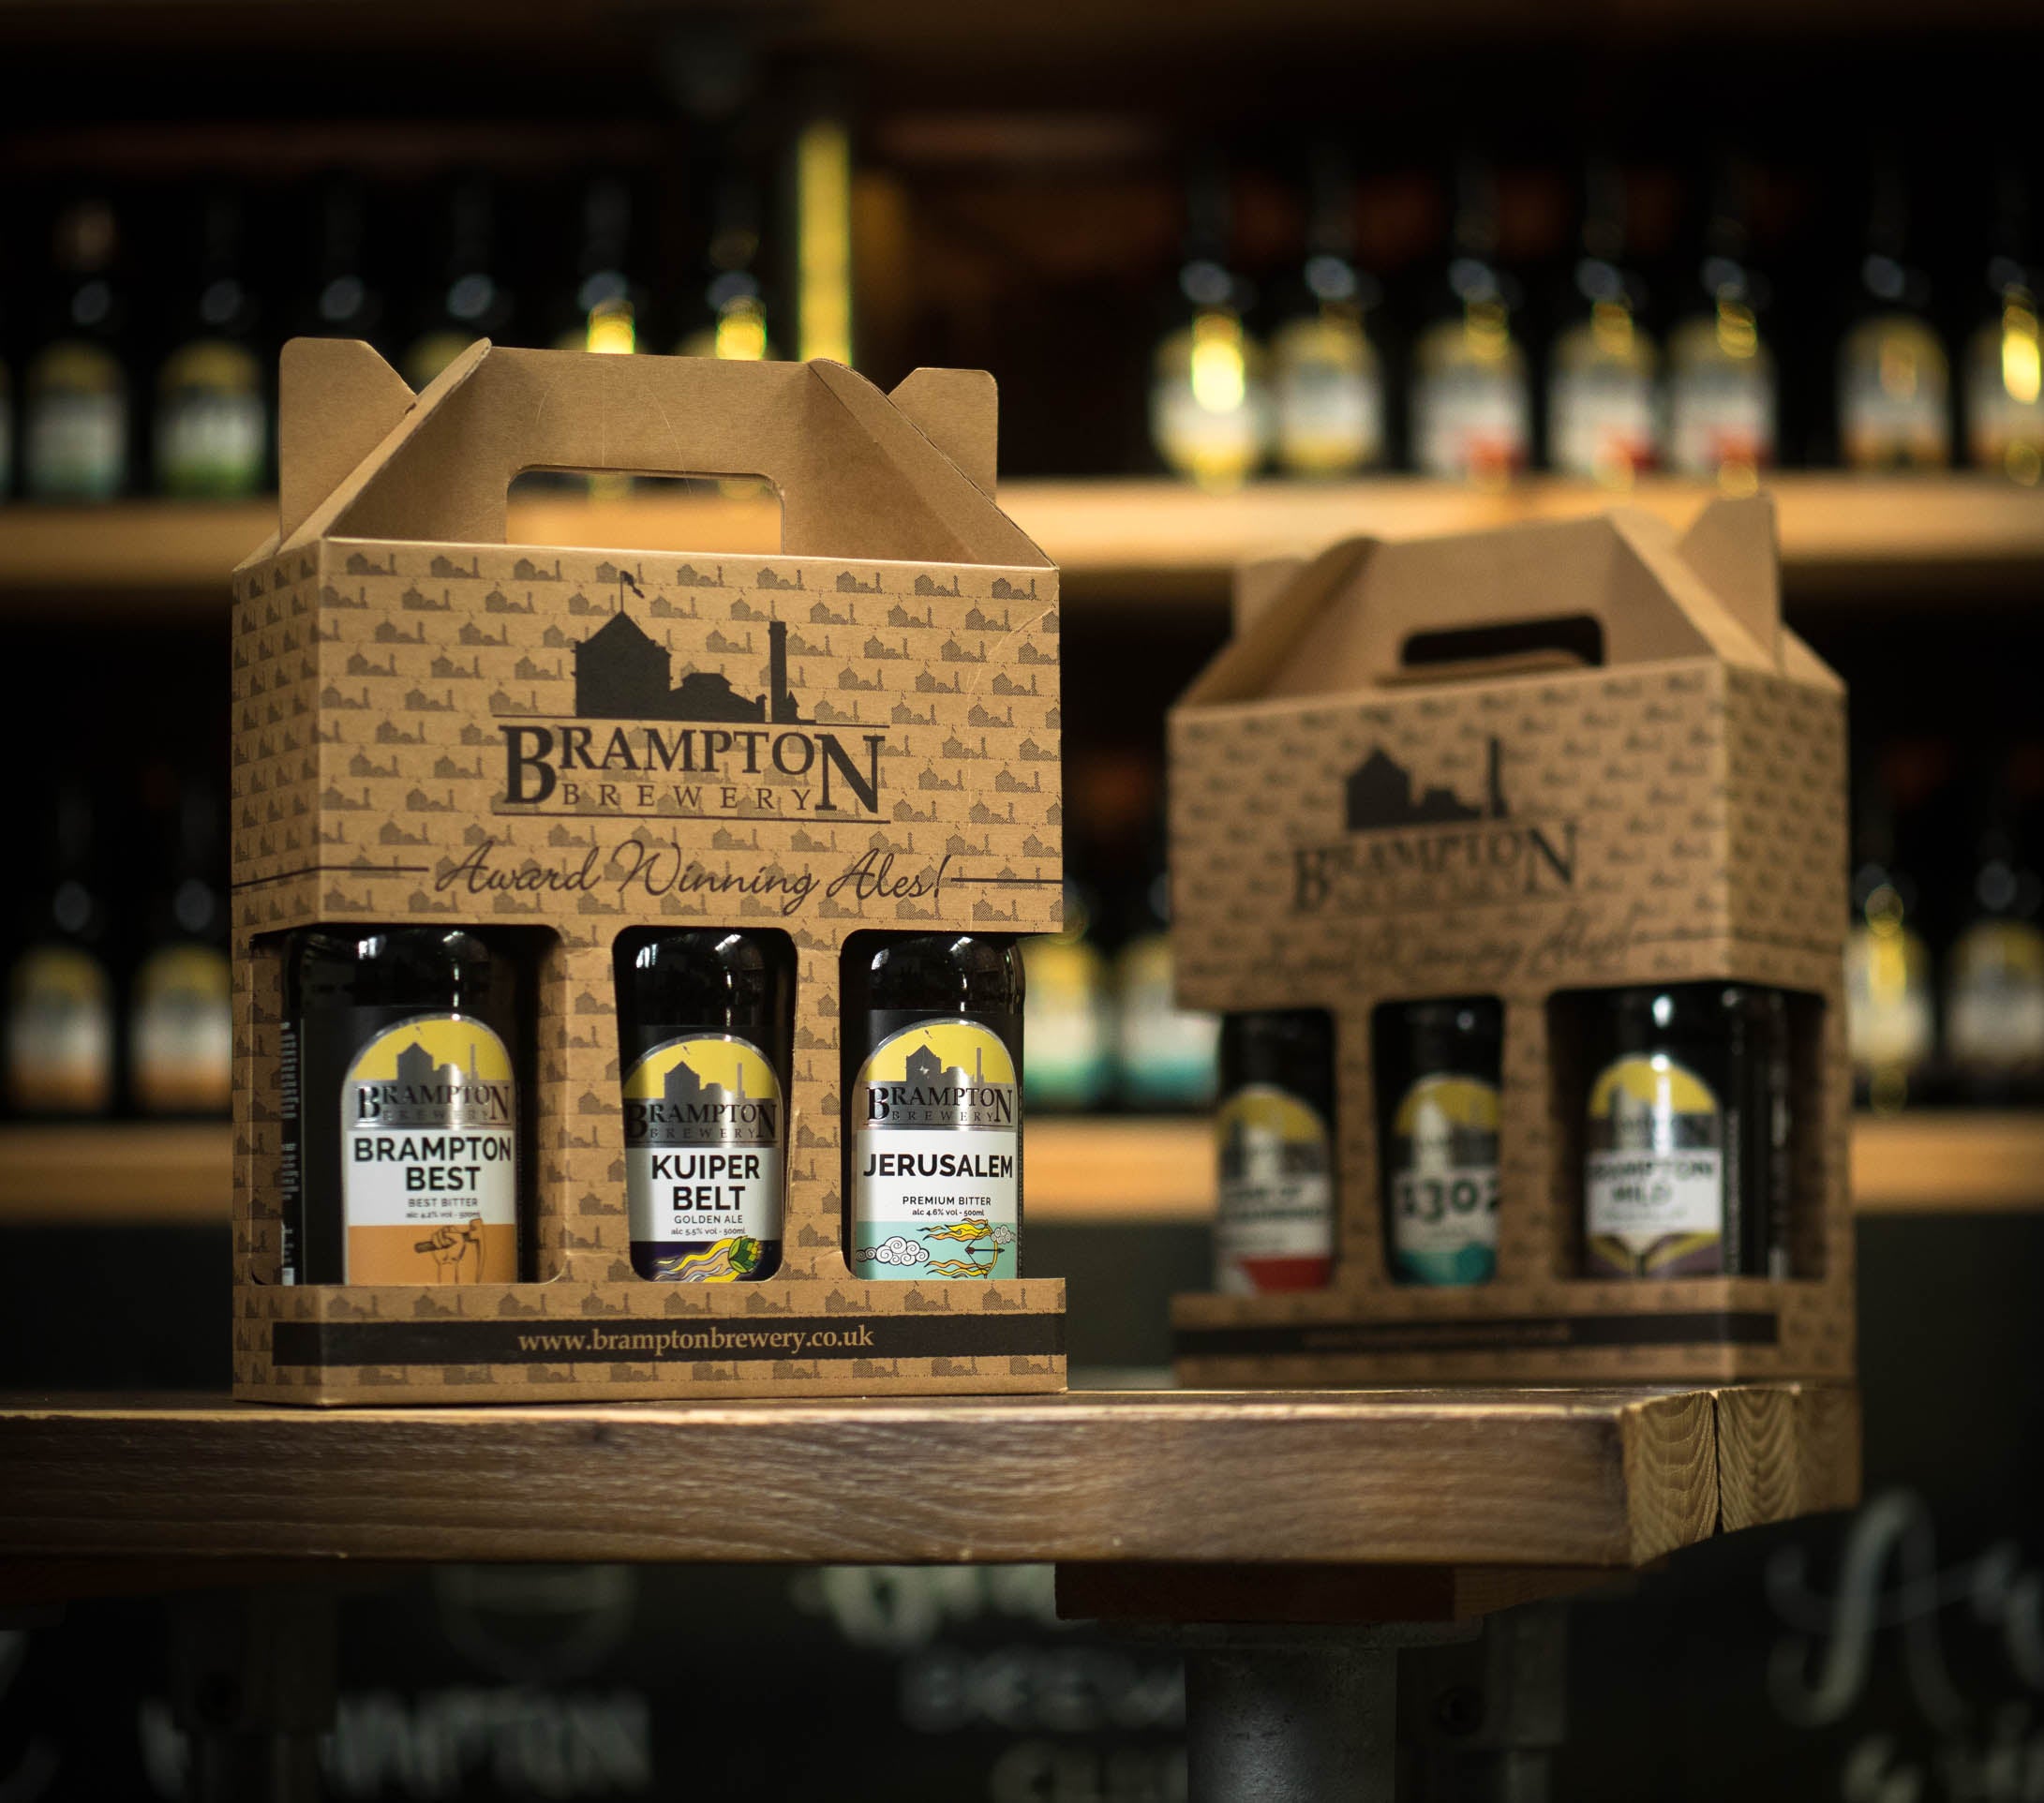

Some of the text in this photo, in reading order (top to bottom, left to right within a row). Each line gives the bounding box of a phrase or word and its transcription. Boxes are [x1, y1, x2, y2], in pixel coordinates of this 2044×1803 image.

[498, 724, 887, 814] BRAMPTON
[562, 783, 812, 812] BREWERY
[435, 840, 952, 916] Award Winning Ales!
[356, 1085, 510, 1121] BRAMPTON
[866, 1086, 1012, 1123] BRAMPTON
[625, 1104, 777, 1139] BRAMPTON
[892, 1110, 995, 1122] BREWERY
[650, 1128, 756, 1139] BREWERY
[354, 1137, 511, 1162] BRAMPTON
[406, 1166, 480, 1191] BEST
[652, 1155, 760, 1180] KUIPER
[863, 1154, 1012, 1178] JERUSALEM
[408, 1198, 478, 1207] BEST BITTER
[673, 1185, 745, 1211] BELT
[903, 1196, 991, 1206] PREMIUM BITTER
[675, 1214, 743, 1224] GOLDEN ALE
[685, 1228, 703, 1236] 5.5%
[724, 1228, 746, 1236] 500ml
[517, 1324, 874, 1357] www.bramptonbrewery.co.uk
